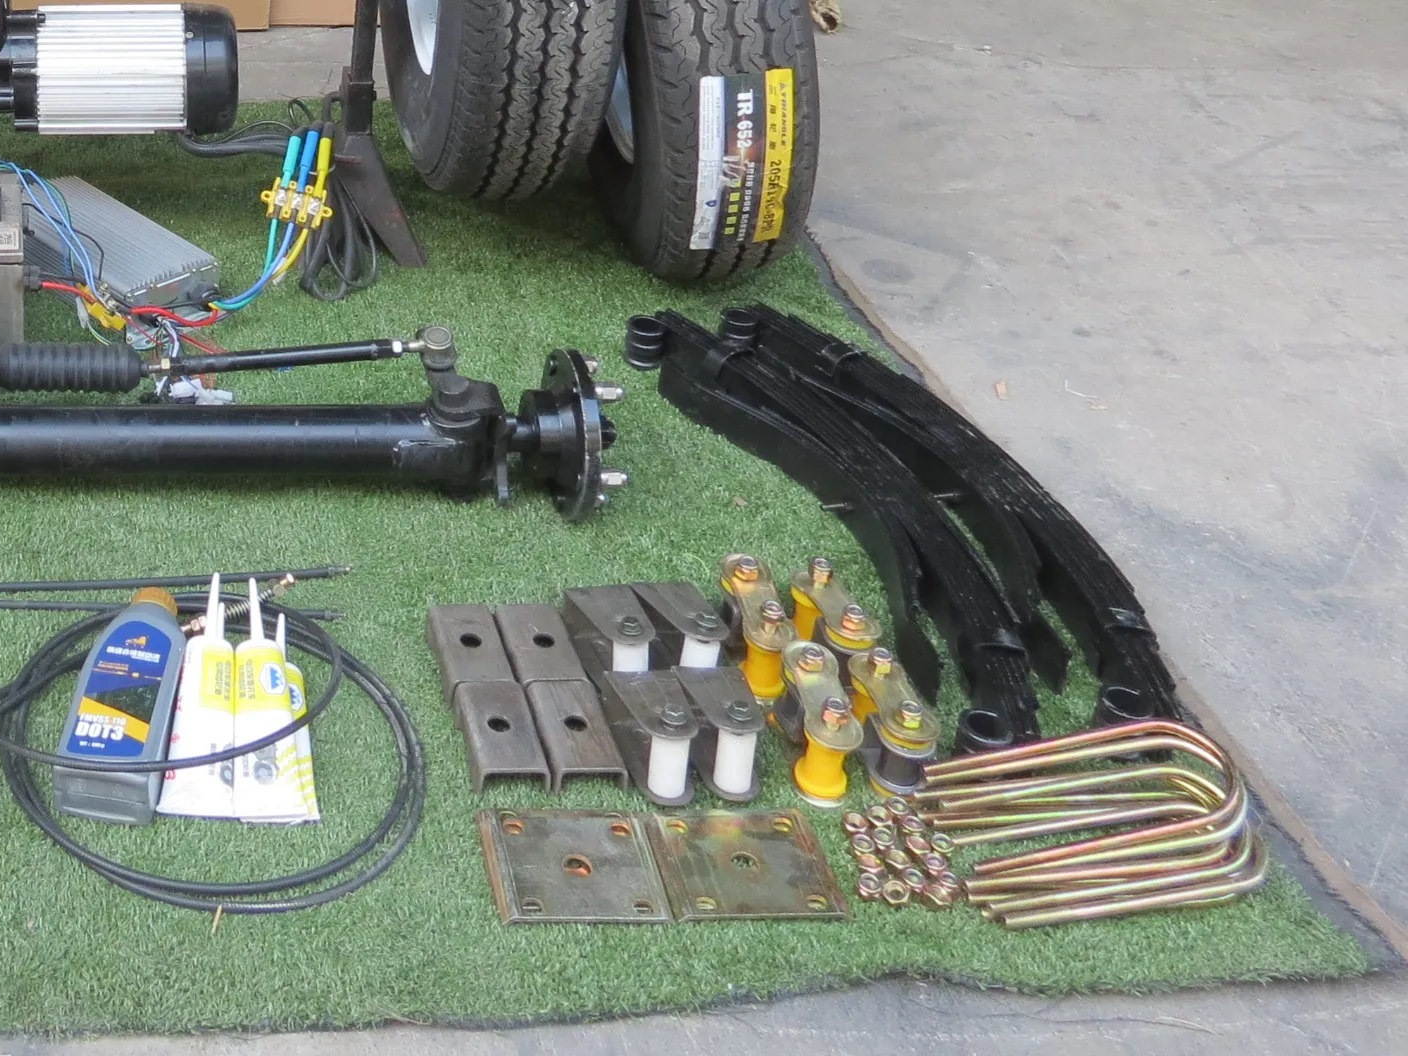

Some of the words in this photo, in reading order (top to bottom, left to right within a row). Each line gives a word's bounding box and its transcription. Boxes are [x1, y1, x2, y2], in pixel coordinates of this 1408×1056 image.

[737, 88, 754, 117] TR
[737, 120, 754, 148] 652
[75, 721, 125, 741] DOT3
